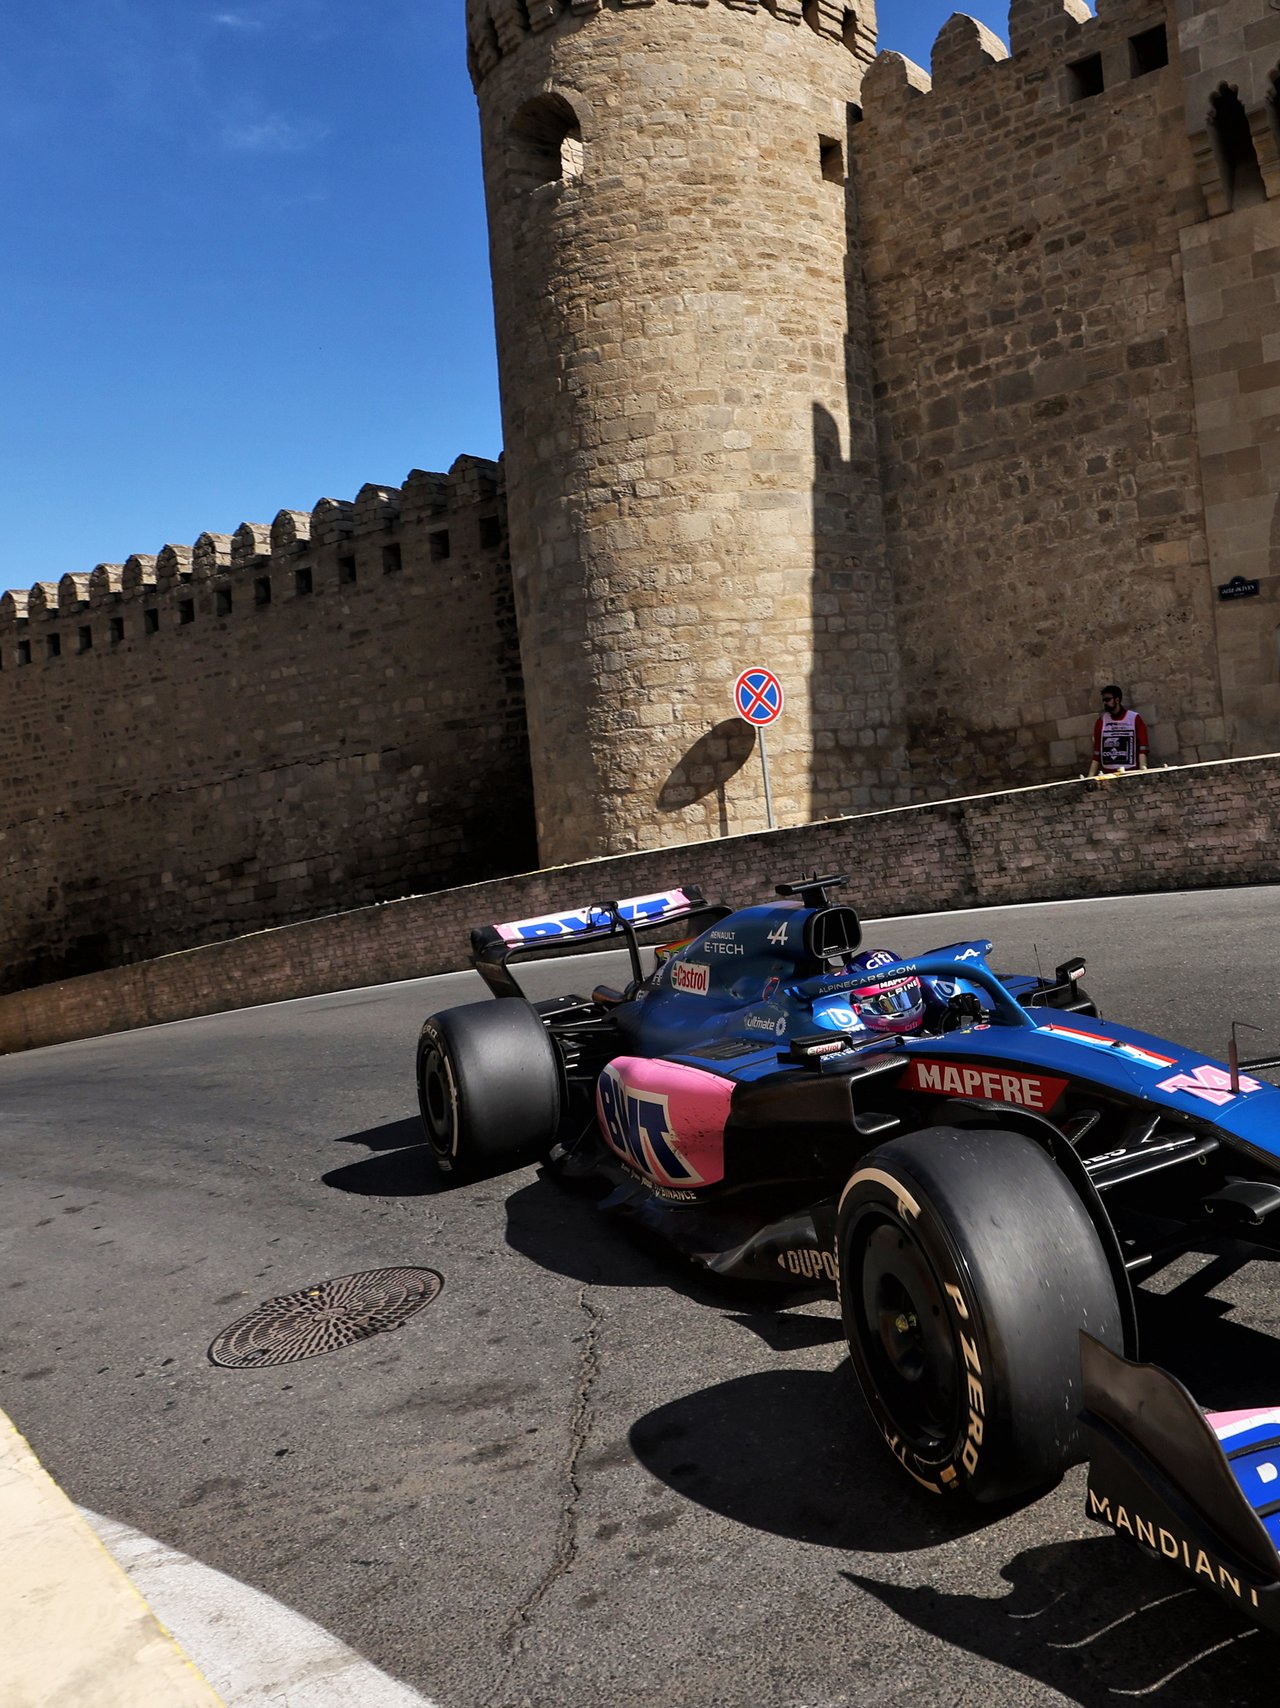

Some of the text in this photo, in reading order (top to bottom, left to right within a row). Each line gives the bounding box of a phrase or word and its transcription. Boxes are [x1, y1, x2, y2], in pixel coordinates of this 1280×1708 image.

[703, 941, 745, 955] E-TECH
[709, 930, 736, 940] RENAULT
[866, 951, 895, 970] citi
[677, 965, 708, 992] Castrol
[818, 963, 918, 994] ALPINECARS.COM
[916, 1062, 1045, 1109] MAPFRE
[598, 1066, 700, 1182] BWT
[786, 1248, 836, 1282] DUPO
[944, 1281, 986, 1477] P ZERO
